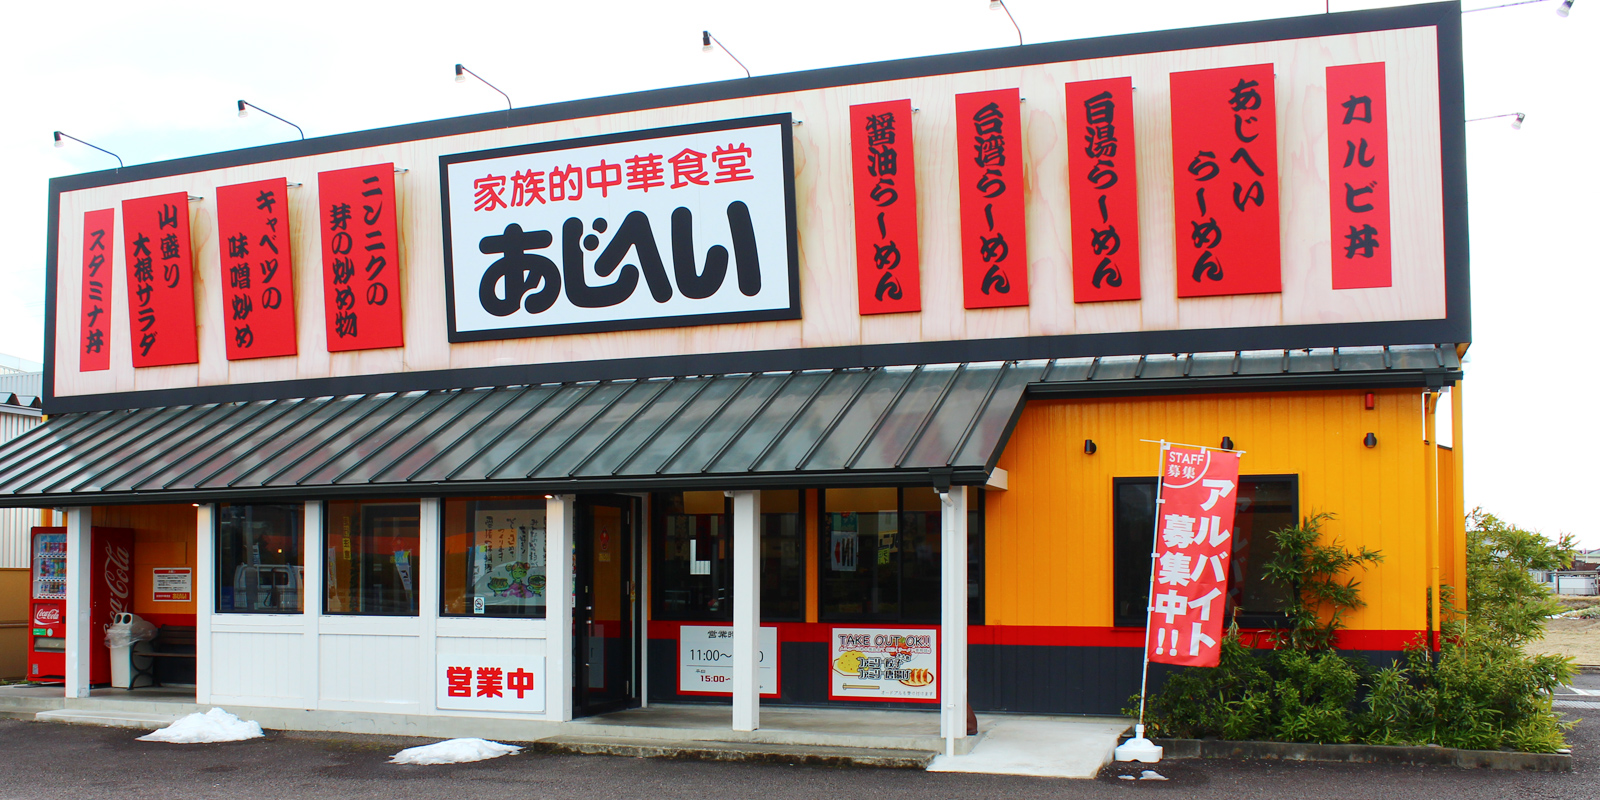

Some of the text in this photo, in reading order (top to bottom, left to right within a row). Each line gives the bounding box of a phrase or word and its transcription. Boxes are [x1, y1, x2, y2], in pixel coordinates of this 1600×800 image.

[473, 142, 755, 212] 家族的中華食堂
[865, 112, 903, 302] 醤油らーめん
[973, 102, 1011, 296] 台湾らーめん
[1228, 78, 1265, 212] あじへい
[1341, 95, 1380, 259] カルビ丼
[157, 203, 181, 289] 山盛り
[256, 190, 282, 310] キャベツの
[330, 202, 358, 338] 芽の炒め物
[361, 176, 388, 306] ニンニクの
[478, 200, 762, 317] あじへい
[1188, 150, 1224, 283] らーめん
[86, 229, 105, 354] スタミナ丼
[132, 232, 159, 357] 大根サラダ
[228, 232, 254, 348] 味噌炒め
[1167, 464, 1196, 479] 募集
[1168, 451, 1204, 466] STAFF
[1188, 478, 1235, 657] アルバイト
[446, 666, 534, 699] 営業中
[839, 634, 930, 647] TAKE OUT OK!!
